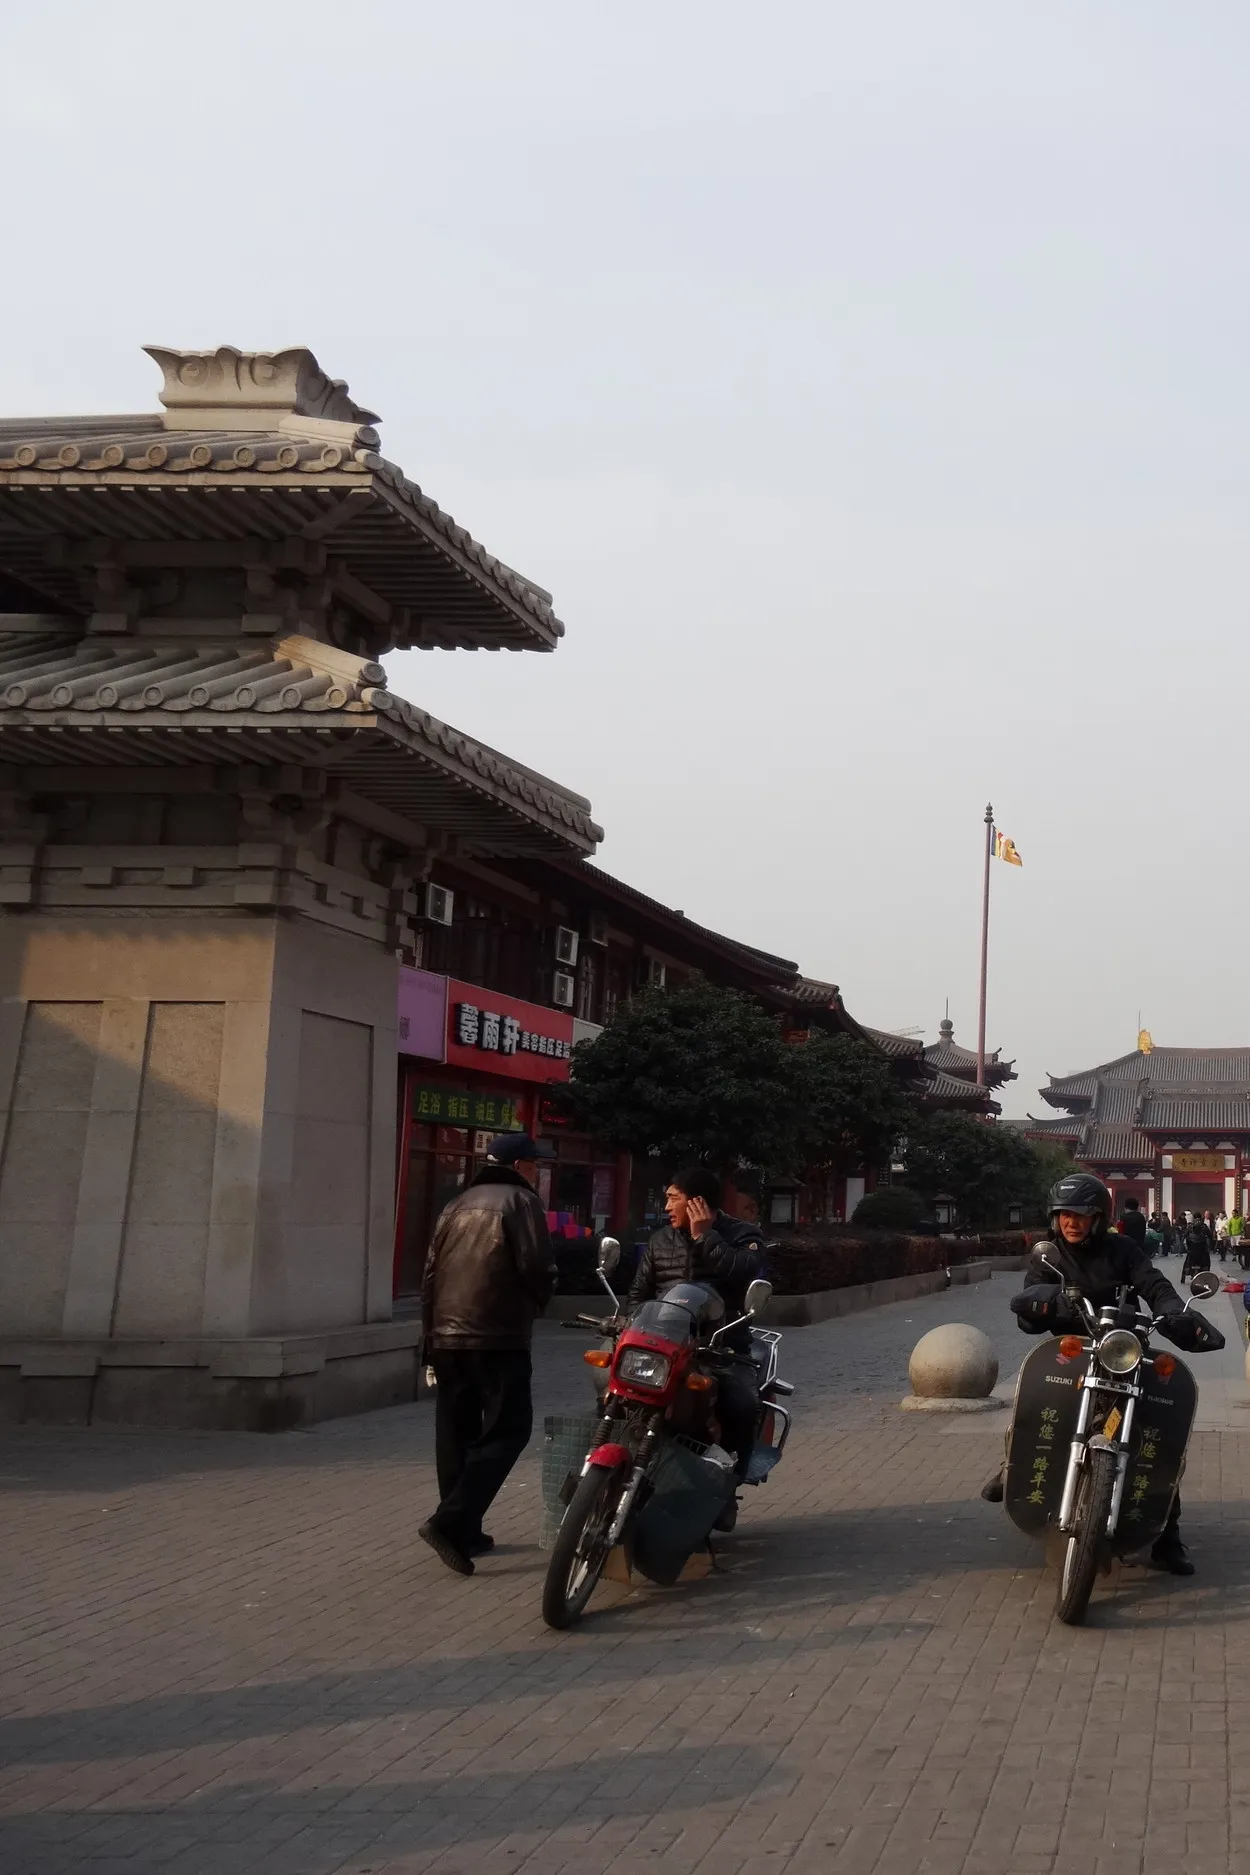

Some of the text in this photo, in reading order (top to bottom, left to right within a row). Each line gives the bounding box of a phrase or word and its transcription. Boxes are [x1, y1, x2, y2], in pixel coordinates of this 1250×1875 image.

[1045, 1375, 1073, 1385] SUZUKI
[1026, 1407, 1059, 1505] 祝您一路平安
[1124, 1427, 1161, 1522] 祝您一路平安
